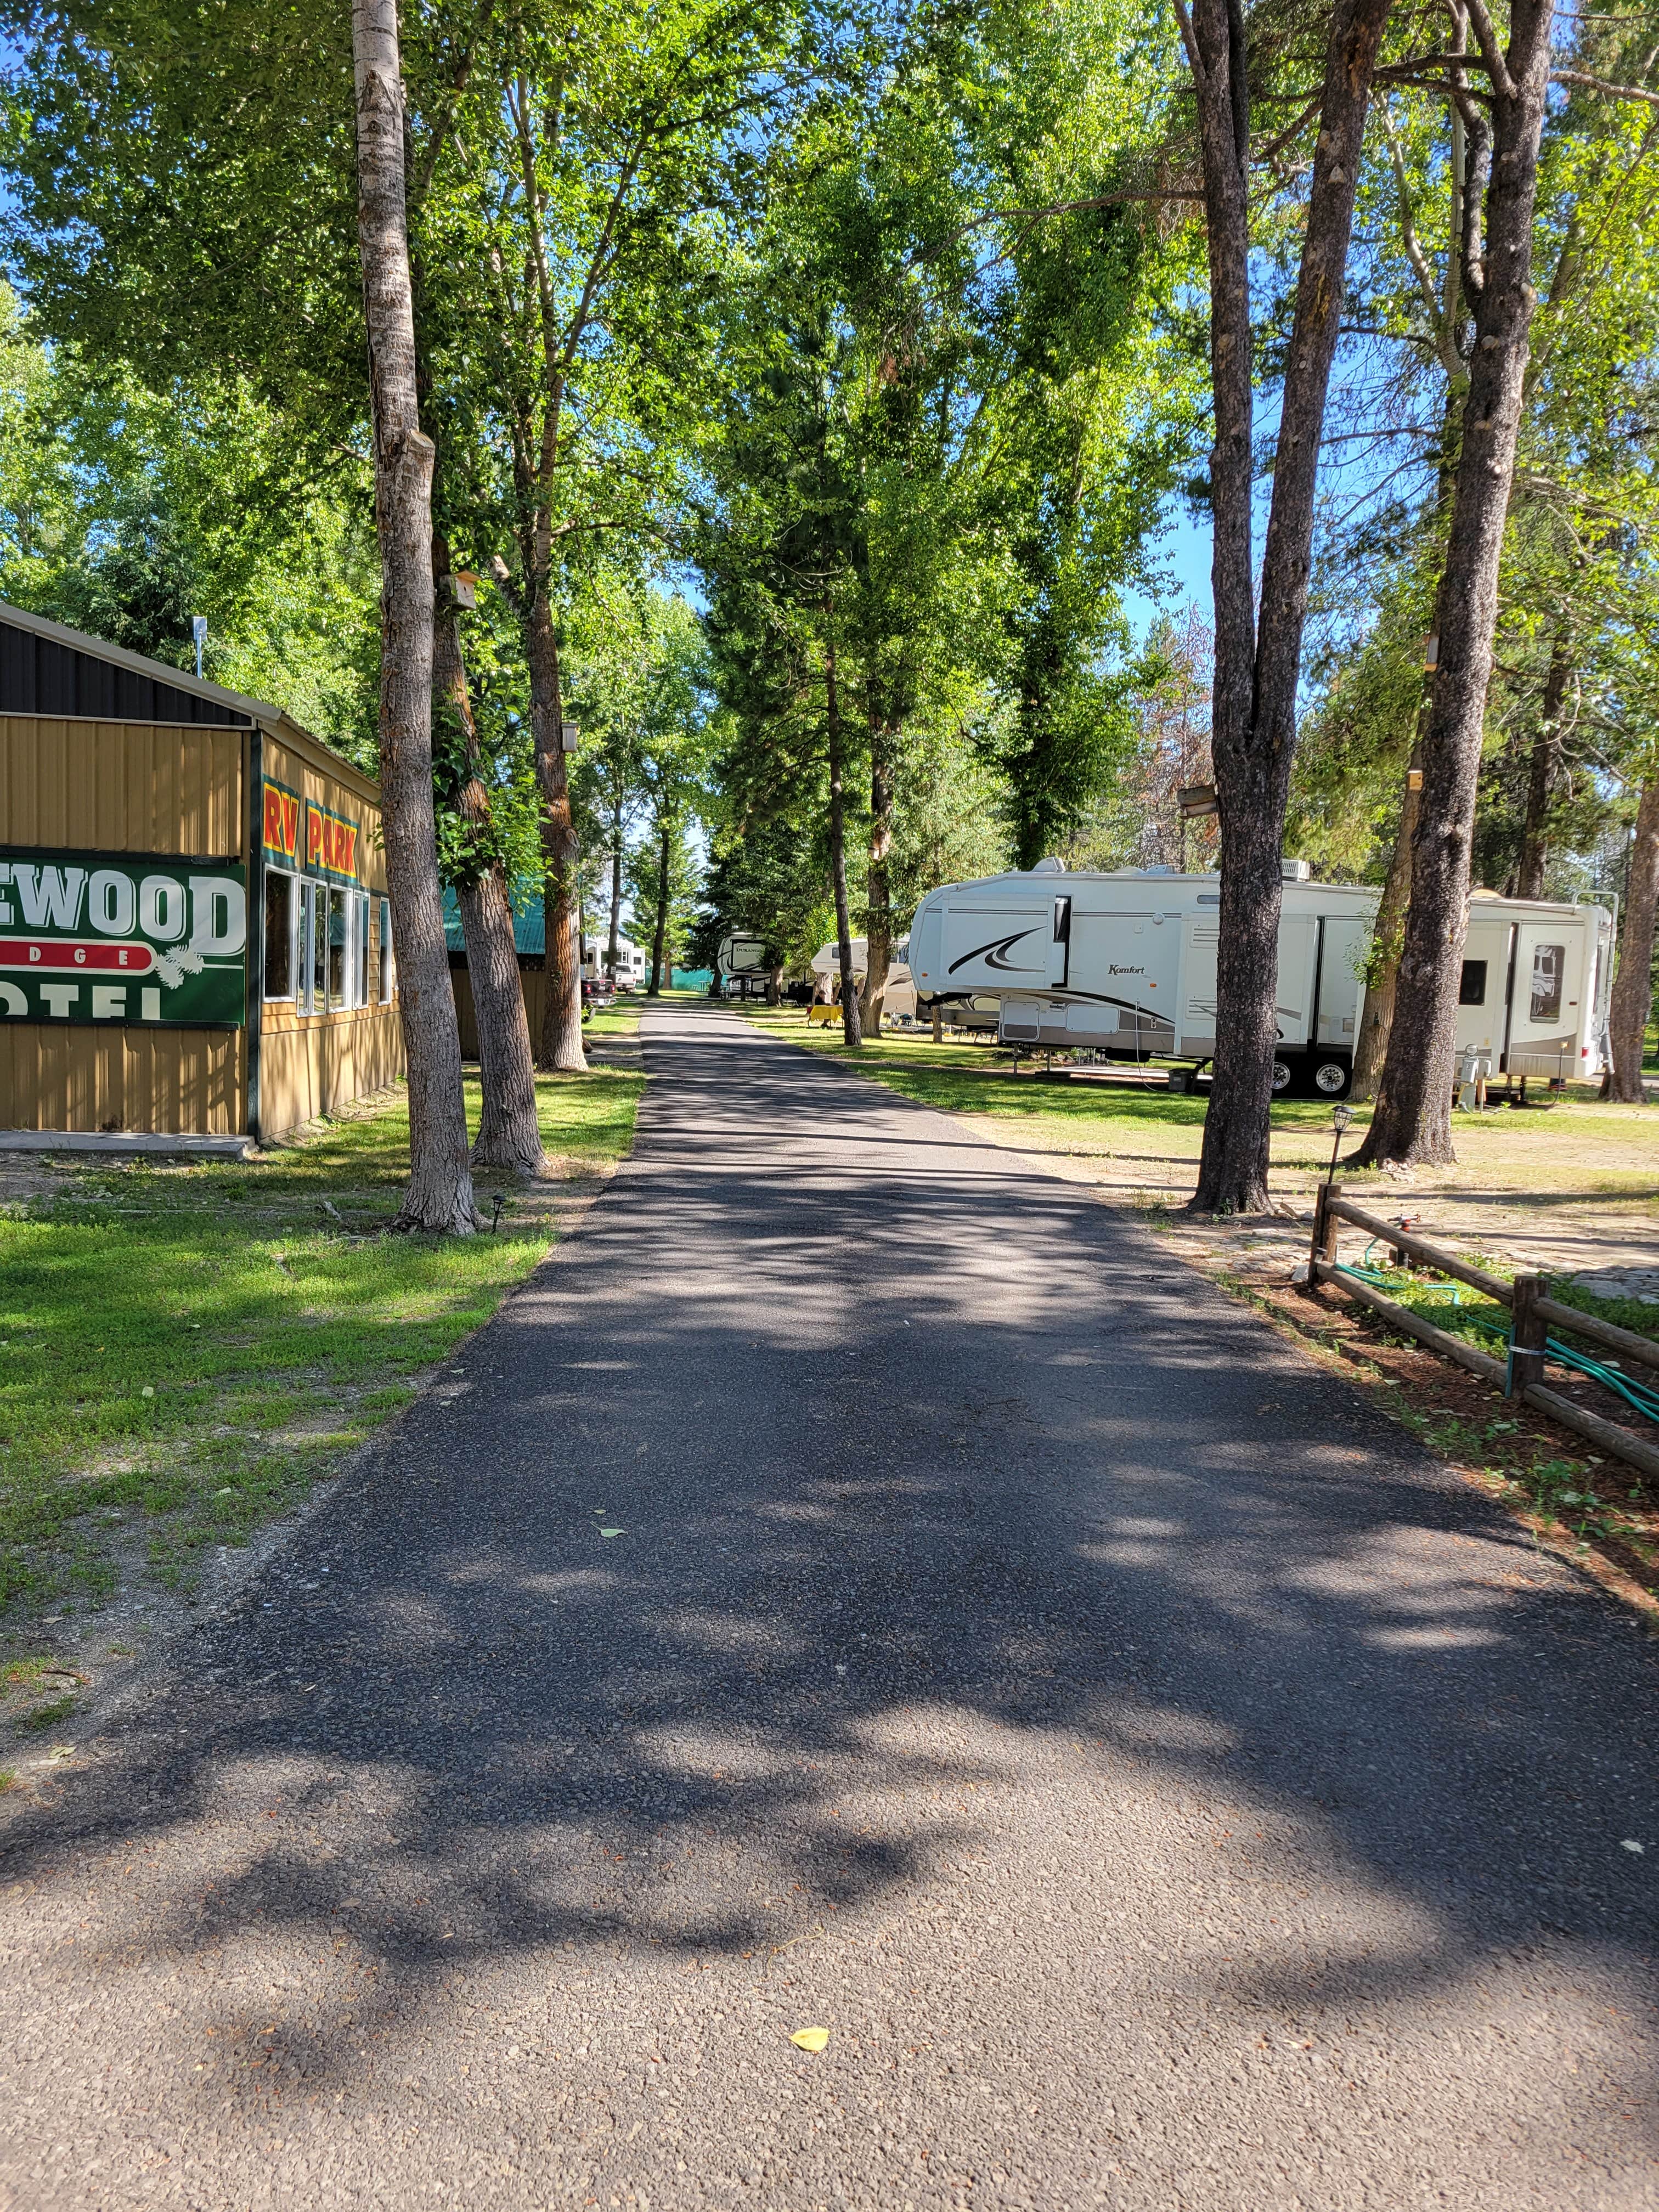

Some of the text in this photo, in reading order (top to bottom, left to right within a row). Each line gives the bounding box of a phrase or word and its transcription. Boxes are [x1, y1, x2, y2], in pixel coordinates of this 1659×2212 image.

[263, 783, 357, 878] RV PARK
[1108, 964, 1145, 975] Komfort
